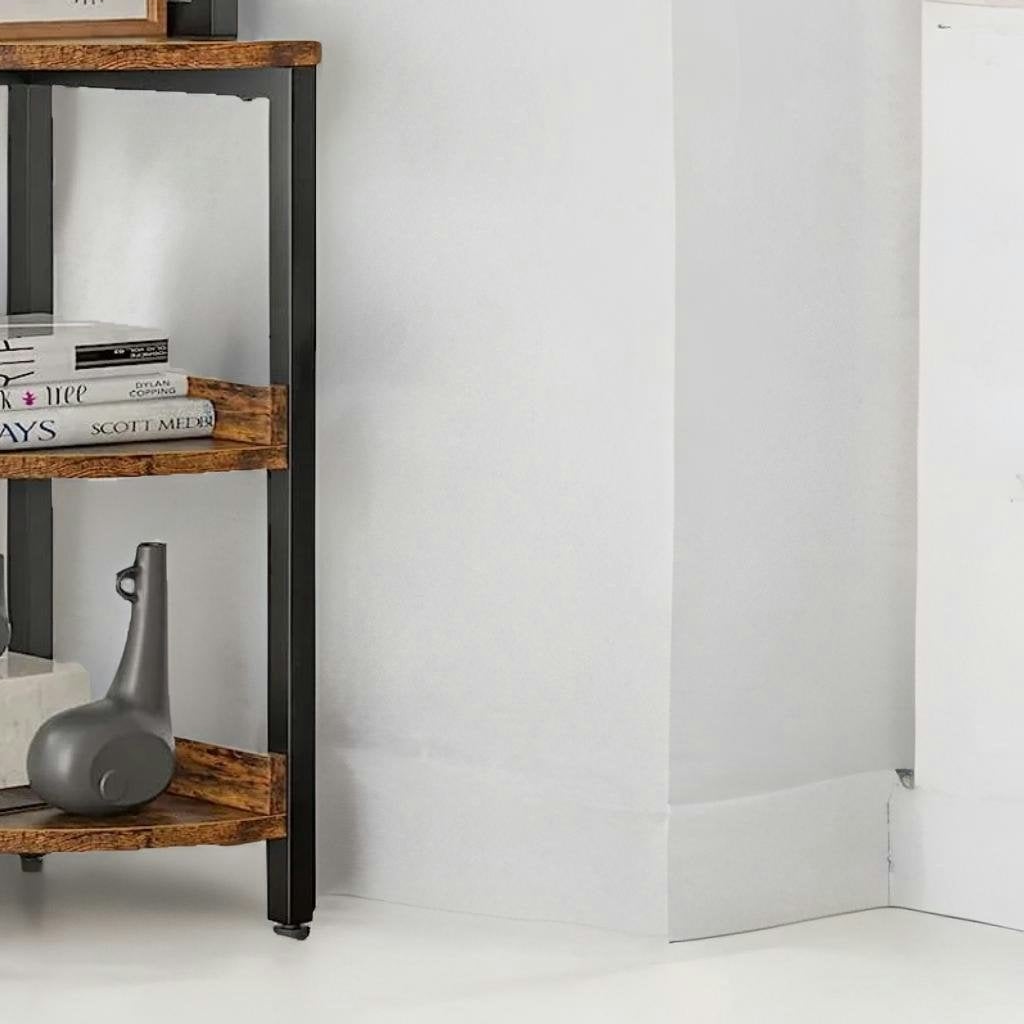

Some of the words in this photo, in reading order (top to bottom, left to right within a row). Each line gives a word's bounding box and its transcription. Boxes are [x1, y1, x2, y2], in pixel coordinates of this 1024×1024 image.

[135, 380, 171, 389] DYLAN
[129, 388, 176, 397] COPPING
[91, 420, 154, 436] SCOTT
